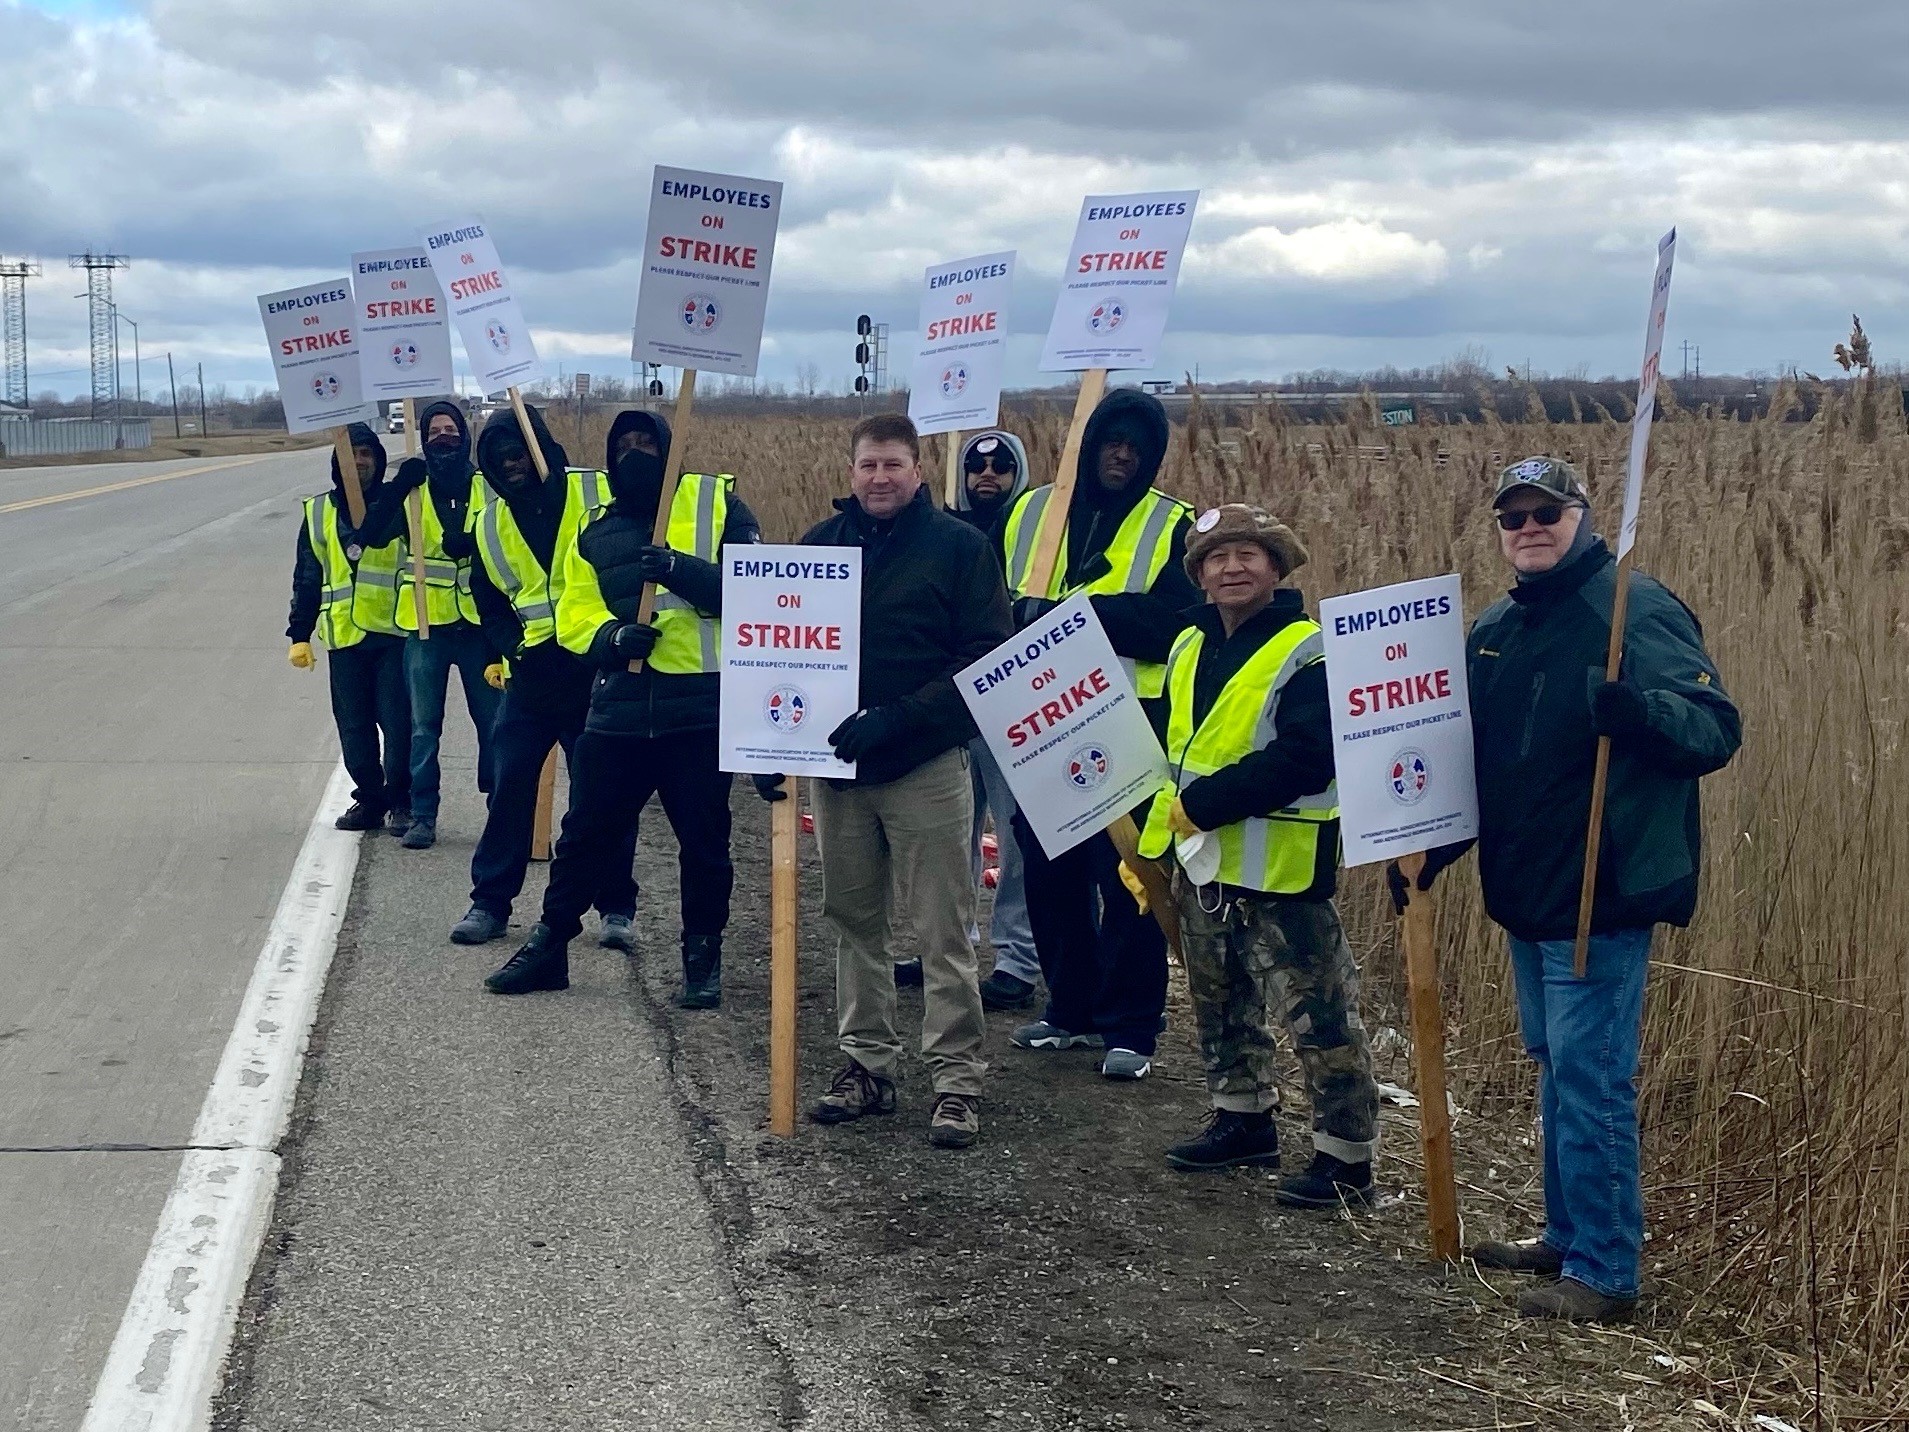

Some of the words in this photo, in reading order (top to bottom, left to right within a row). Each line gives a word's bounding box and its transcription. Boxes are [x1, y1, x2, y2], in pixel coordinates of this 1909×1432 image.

[662, 180, 771, 209] EMPLOYEES
[701, 215, 724, 229] ON
[1087, 202, 1186, 221] EMPLOYEES
[428, 225, 484, 249] EMPLOYEES
[1119, 229, 1141, 240] ON
[460, 253, 475, 265] ON
[660, 236, 758, 269] STRIKE
[1077, 250, 1169, 274] STRIKE
[359, 257, 432, 274] EMPLOYEE
[651, 265, 674, 276] PLEASE
[930, 263, 1007, 289] EMPLOYEES
[391, 281, 407, 291] ON
[450, 270, 502, 300] STRIKE
[268, 289, 346, 314] EMPLOYEES
[367, 298, 436, 319] STRIKE
[956, 293, 973, 305] ON
[303, 315, 320, 326] ON
[927, 312, 997, 340] STRIKE
[281, 329, 352, 355] STRIKE
[733, 560, 850, 580] EMPLOYEES
[777, 594, 801, 608] ON
[1335, 595, 1450, 636] EMPLOYEES
[737, 623, 841, 650] STRIKE
[973, 611, 1087, 695] EMPLOYEES
[1385, 642, 1408, 661] ON
[729, 659, 755, 667] PLEASE
[756, 660, 787, 668] RESPECT
[805, 663, 831, 671] PICKET
[1031, 667, 1057, 690] ON
[1349, 669, 1452, 717] STRIKE
[1007, 667, 1111, 748] STRIKE
[1012, 751, 1039, 769] PLEASE
[1039, 732, 1070, 752] RESPECT
[1071, 721, 1086, 734] OUR
[1086, 704, 1110, 723] PICKET
[1110, 693, 1126, 706] LINE
[1343, 730, 1371, 742] PLEASE
[1373, 723, 1405, 736] RESPECT
[1405, 719, 1420, 728] OUR
[1422, 713, 1446, 725] PICKET
[1447, 709, 1462, 720] LINE
